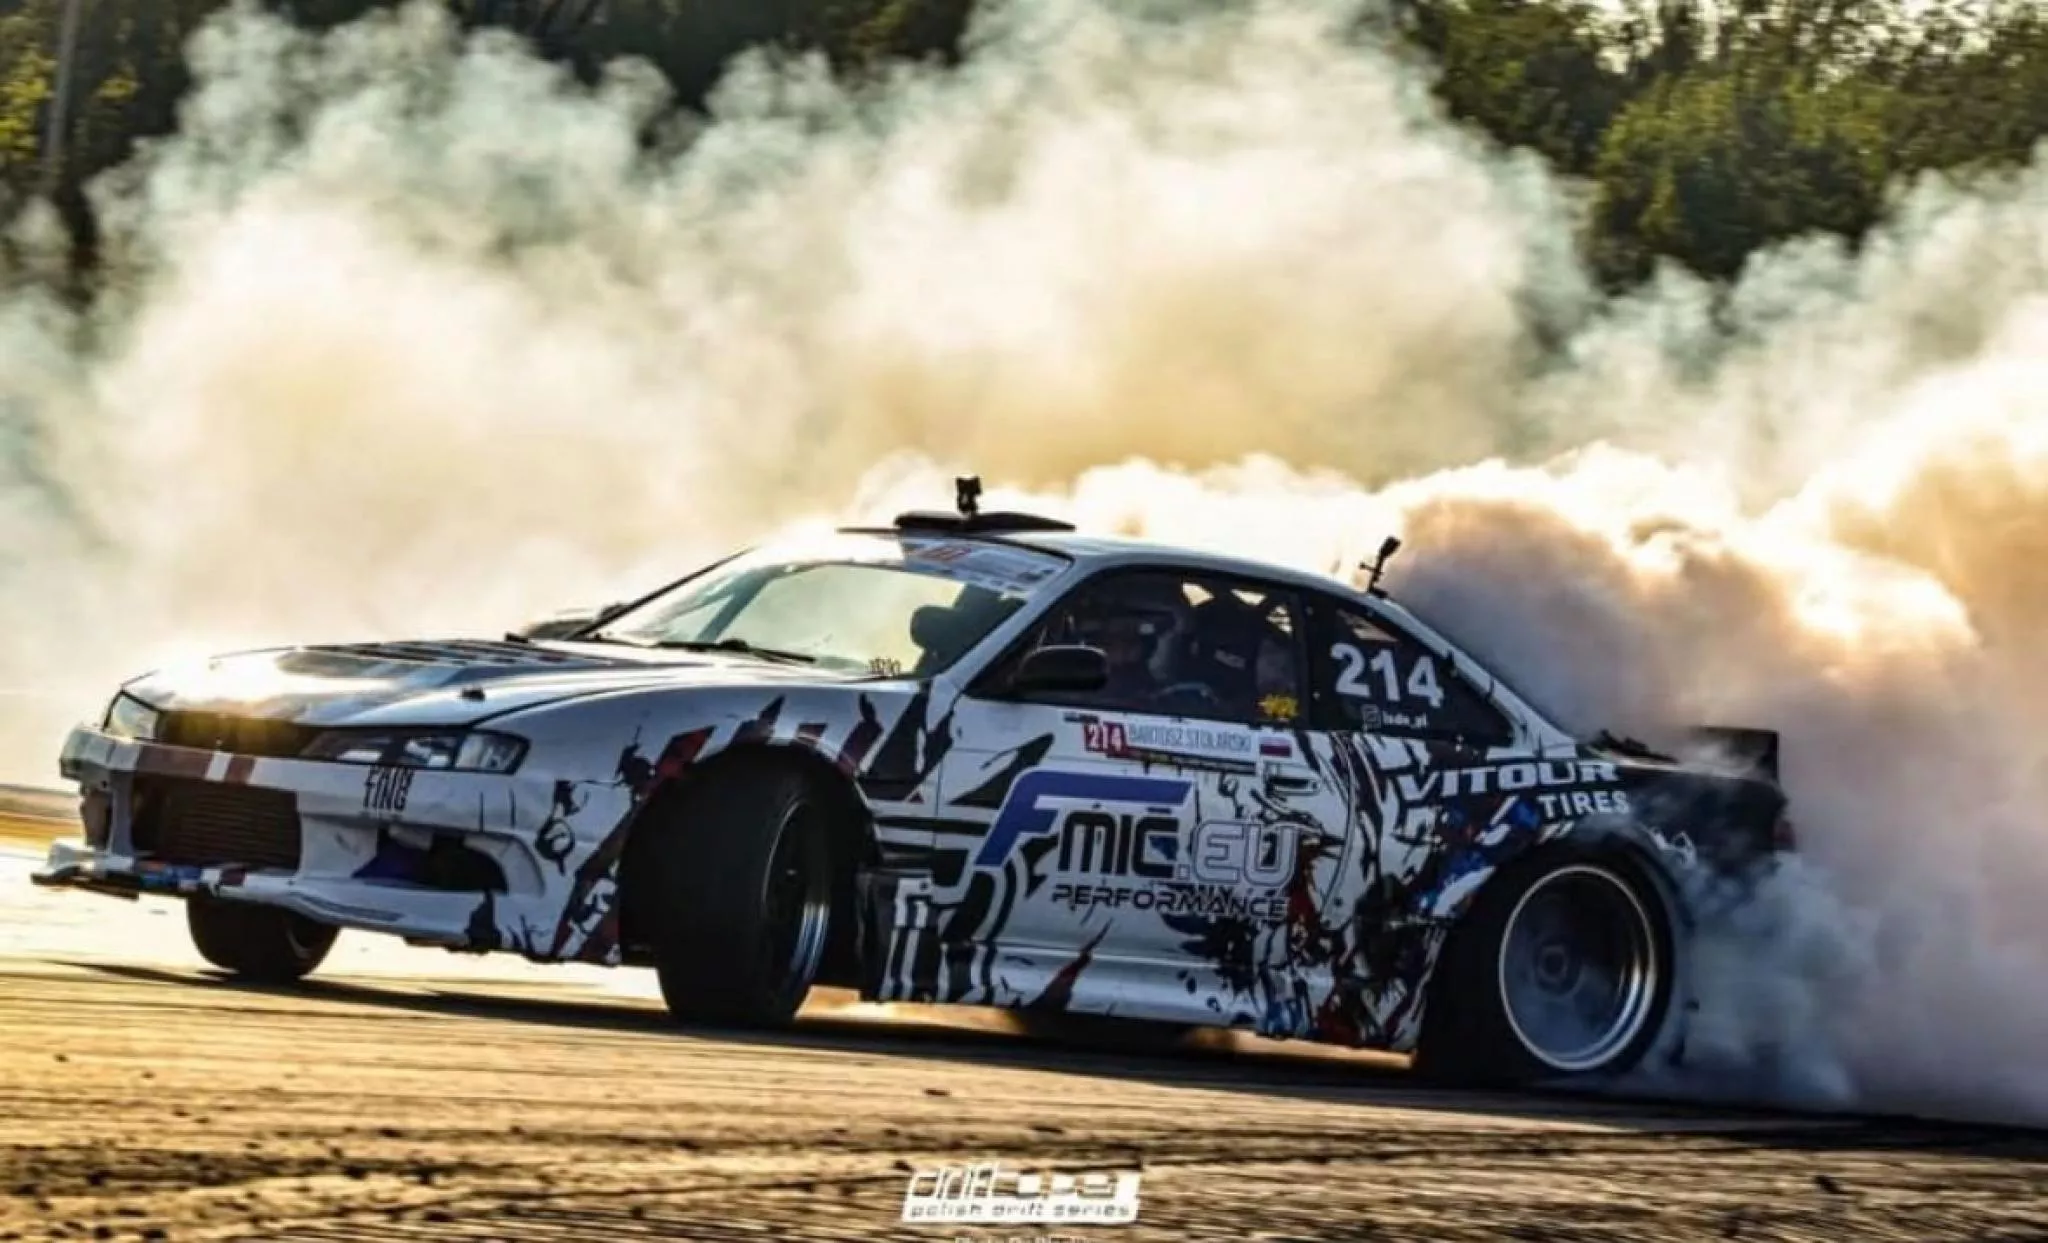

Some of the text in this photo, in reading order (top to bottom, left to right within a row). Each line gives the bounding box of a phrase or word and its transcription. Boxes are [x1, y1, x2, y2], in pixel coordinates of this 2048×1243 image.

[1330, 641, 1444, 707] 214
[1086, 721, 1123, 752] 214
[1397, 759, 1620, 801] VITOUR
[1536, 790, 1630, 818] TIRES
[1052, 884, 1289, 918] PERFORMANCE
